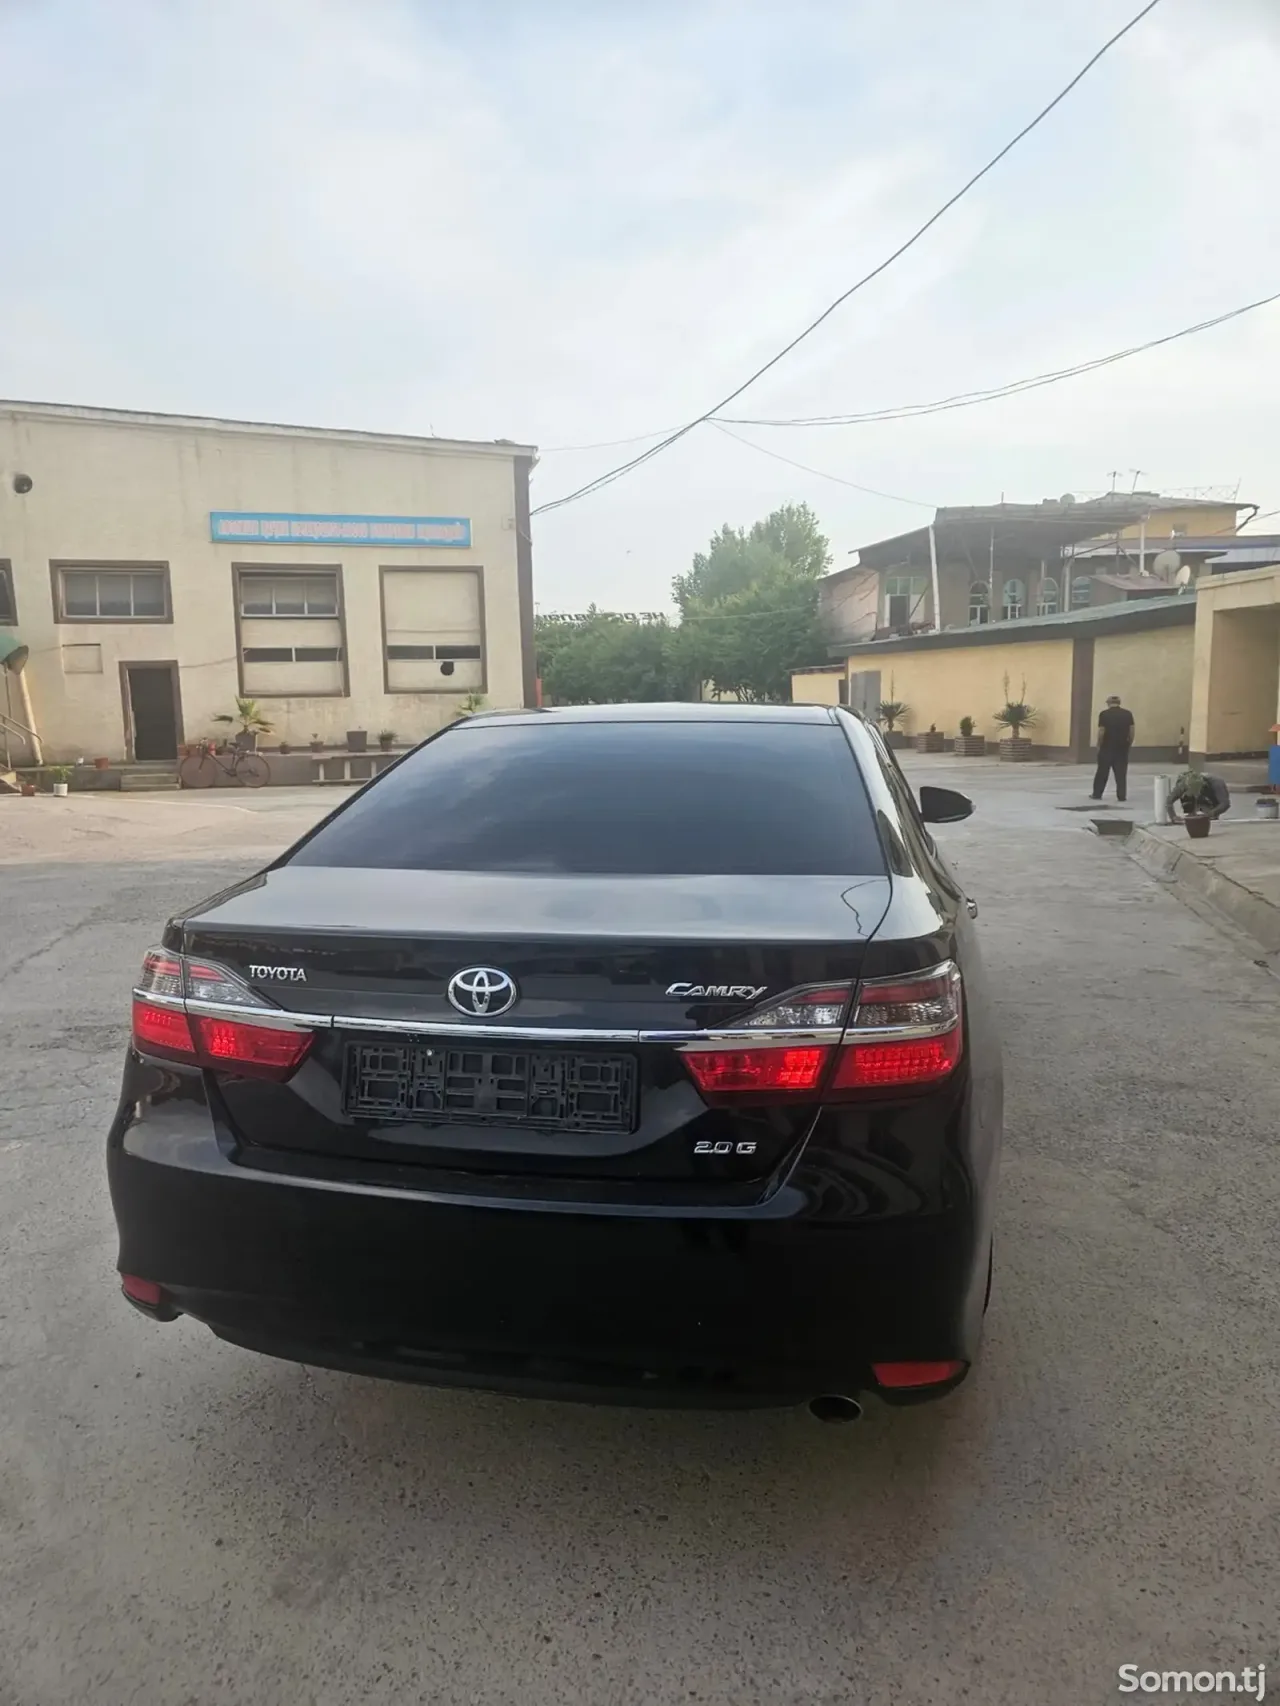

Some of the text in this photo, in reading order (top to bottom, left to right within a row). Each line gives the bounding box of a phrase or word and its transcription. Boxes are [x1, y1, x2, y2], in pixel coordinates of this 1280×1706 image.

[248, 964, 307, 982] TOYOTA
[665, 982, 768, 1000] CAMRY
[693, 1141, 757, 1154] 2.0 G
